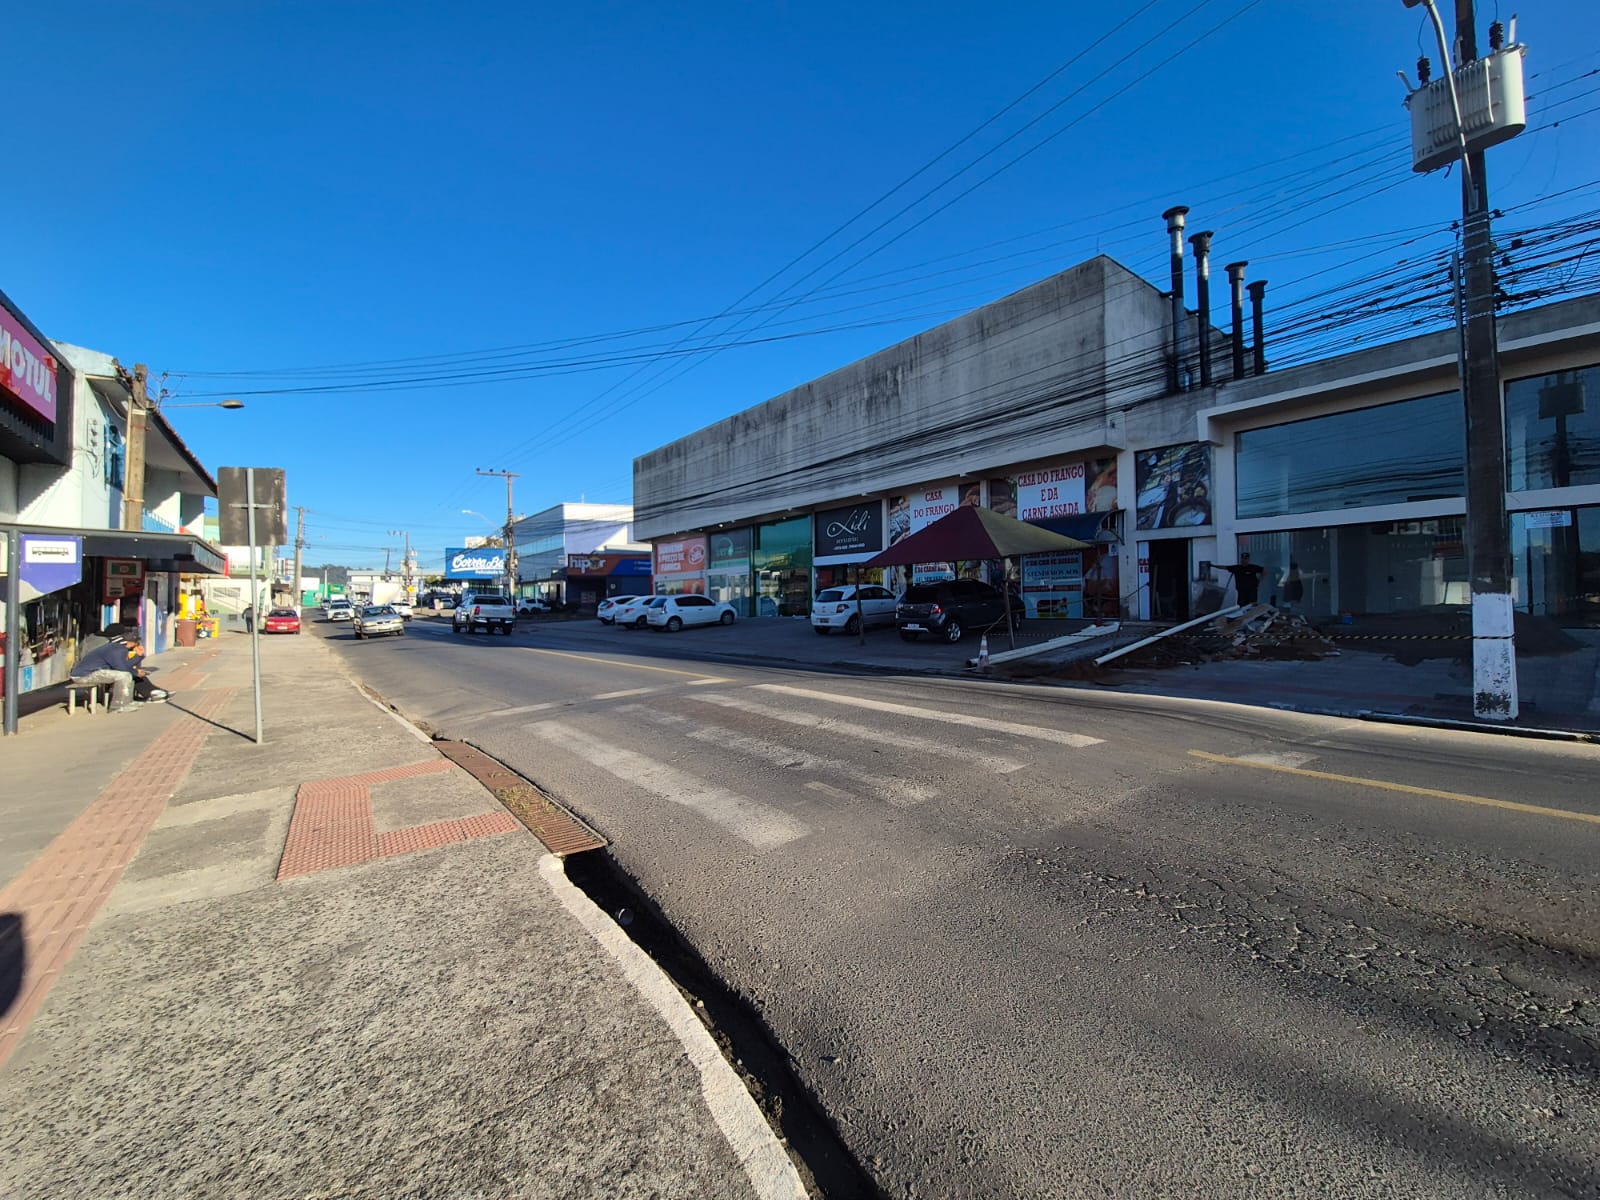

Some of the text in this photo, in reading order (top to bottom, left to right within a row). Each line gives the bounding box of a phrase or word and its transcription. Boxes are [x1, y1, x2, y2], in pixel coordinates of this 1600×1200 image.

[0, 324, 52, 402] MOTUL
[1018, 465, 1084, 487] CASA DO FRANGO
[925, 490, 942, 502] CASA
[1041, 487, 1059, 502] E DA
[914, 503, 955, 518] DO FRANGO
[1022, 502, 1080, 520] CARNE ASSADA
